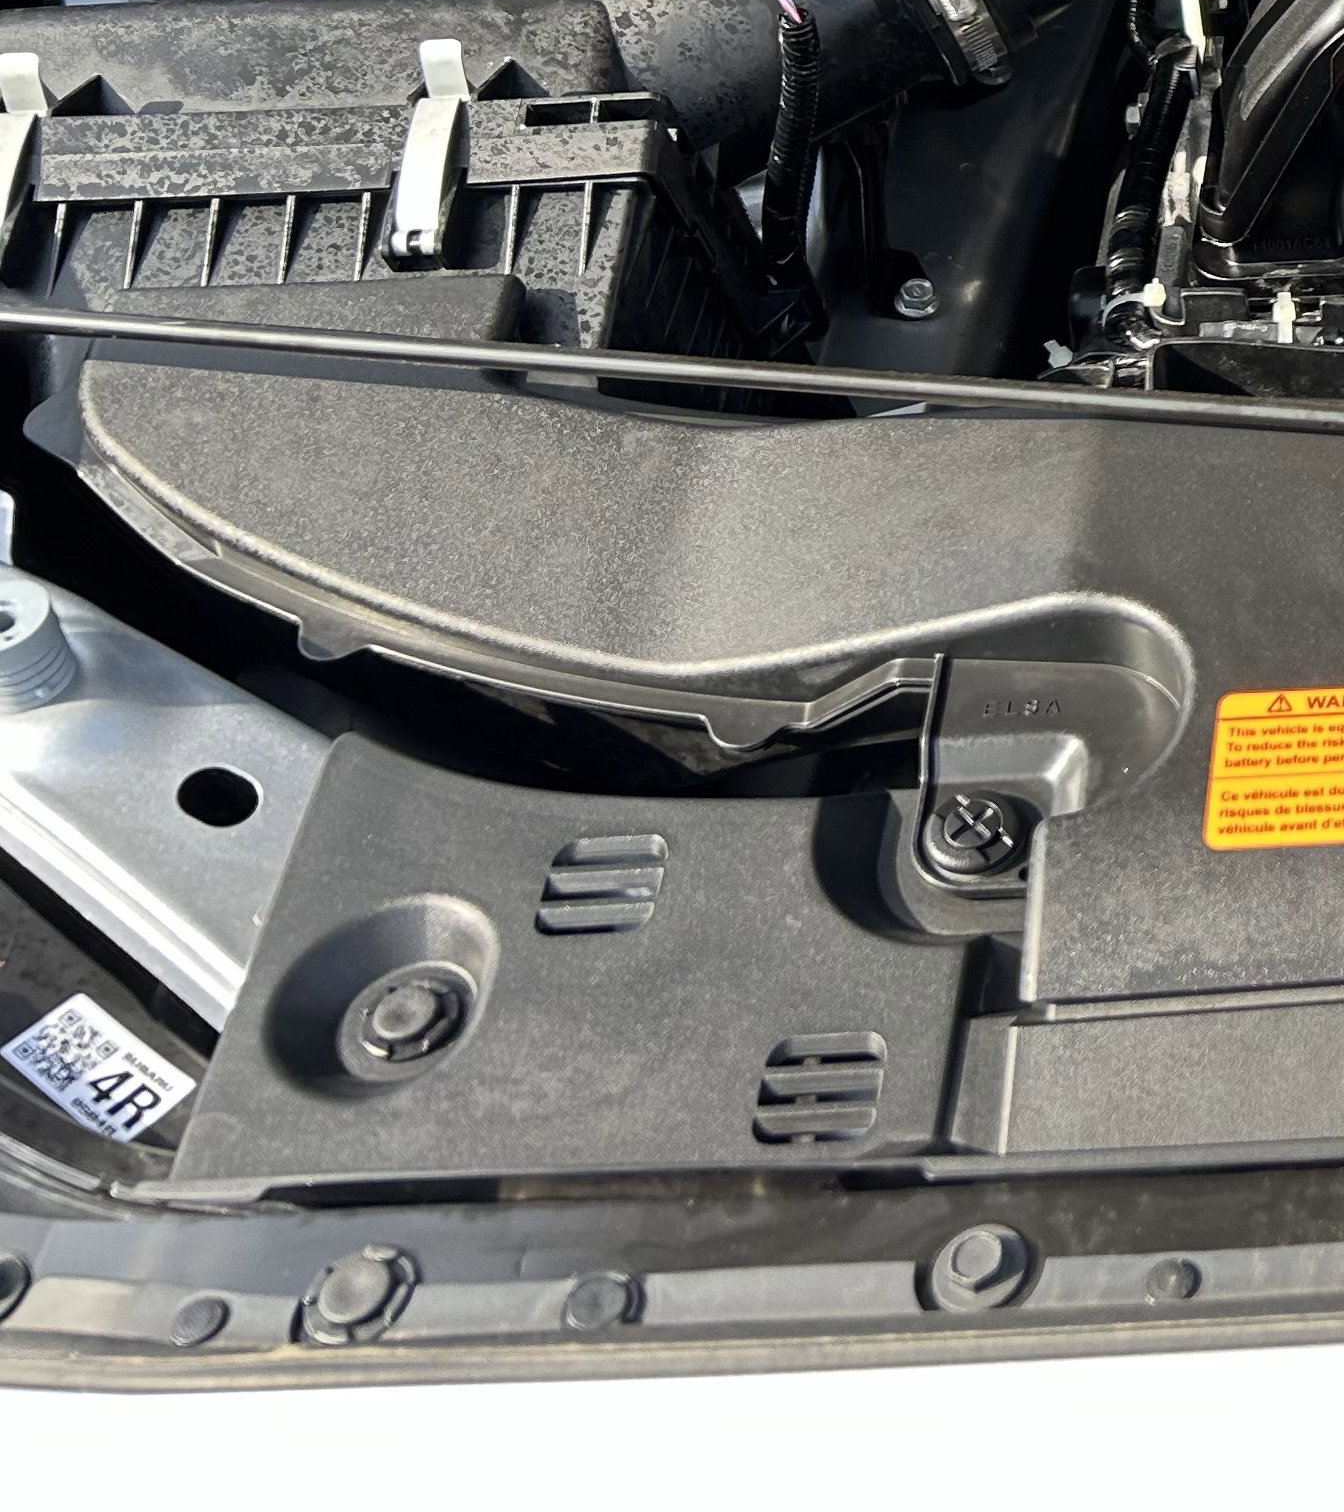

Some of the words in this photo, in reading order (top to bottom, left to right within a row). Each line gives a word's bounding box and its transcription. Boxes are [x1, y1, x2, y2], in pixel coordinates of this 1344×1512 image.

[1228, 726, 1256, 737] This
[1261, 723, 1308, 735] vehicle
[1246, 739, 1292, 751] reduce
[1297, 738, 1317, 748] the
[1322, 737, 1344, 747] risk
[1224, 756, 1270, 770] battery
[1276, 753, 1319, 765] before
[1244, 787, 1299, 800] véhicule
[1303, 786, 1323, 796] est
[1218, 806, 1270, 820] risques
[1218, 821, 1274, 835] véhicule
[1279, 819, 1317, 831] avant
[87, 1070, 162, 1131] 4R
